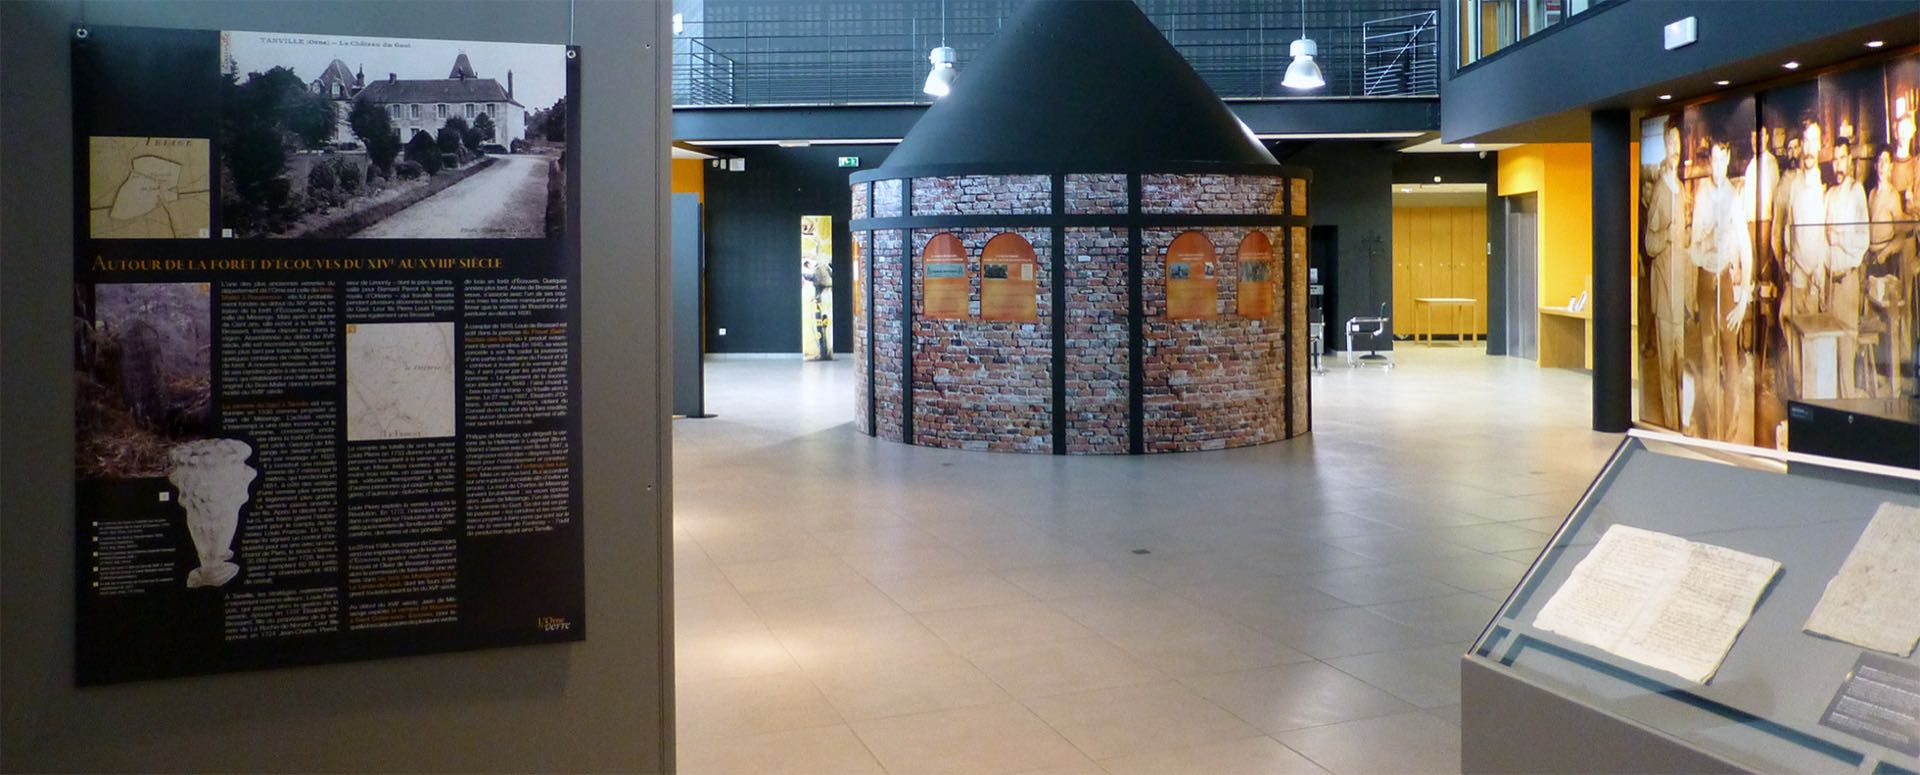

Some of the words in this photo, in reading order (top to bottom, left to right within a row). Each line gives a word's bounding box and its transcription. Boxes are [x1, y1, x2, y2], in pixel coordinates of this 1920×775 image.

[92, 254, 162, 271] AUTOUR
[165, 258, 185, 271] DE
[188, 258, 207, 271] LA
[344, 258, 363, 270] DU
[399, 257, 418, 270] AU
